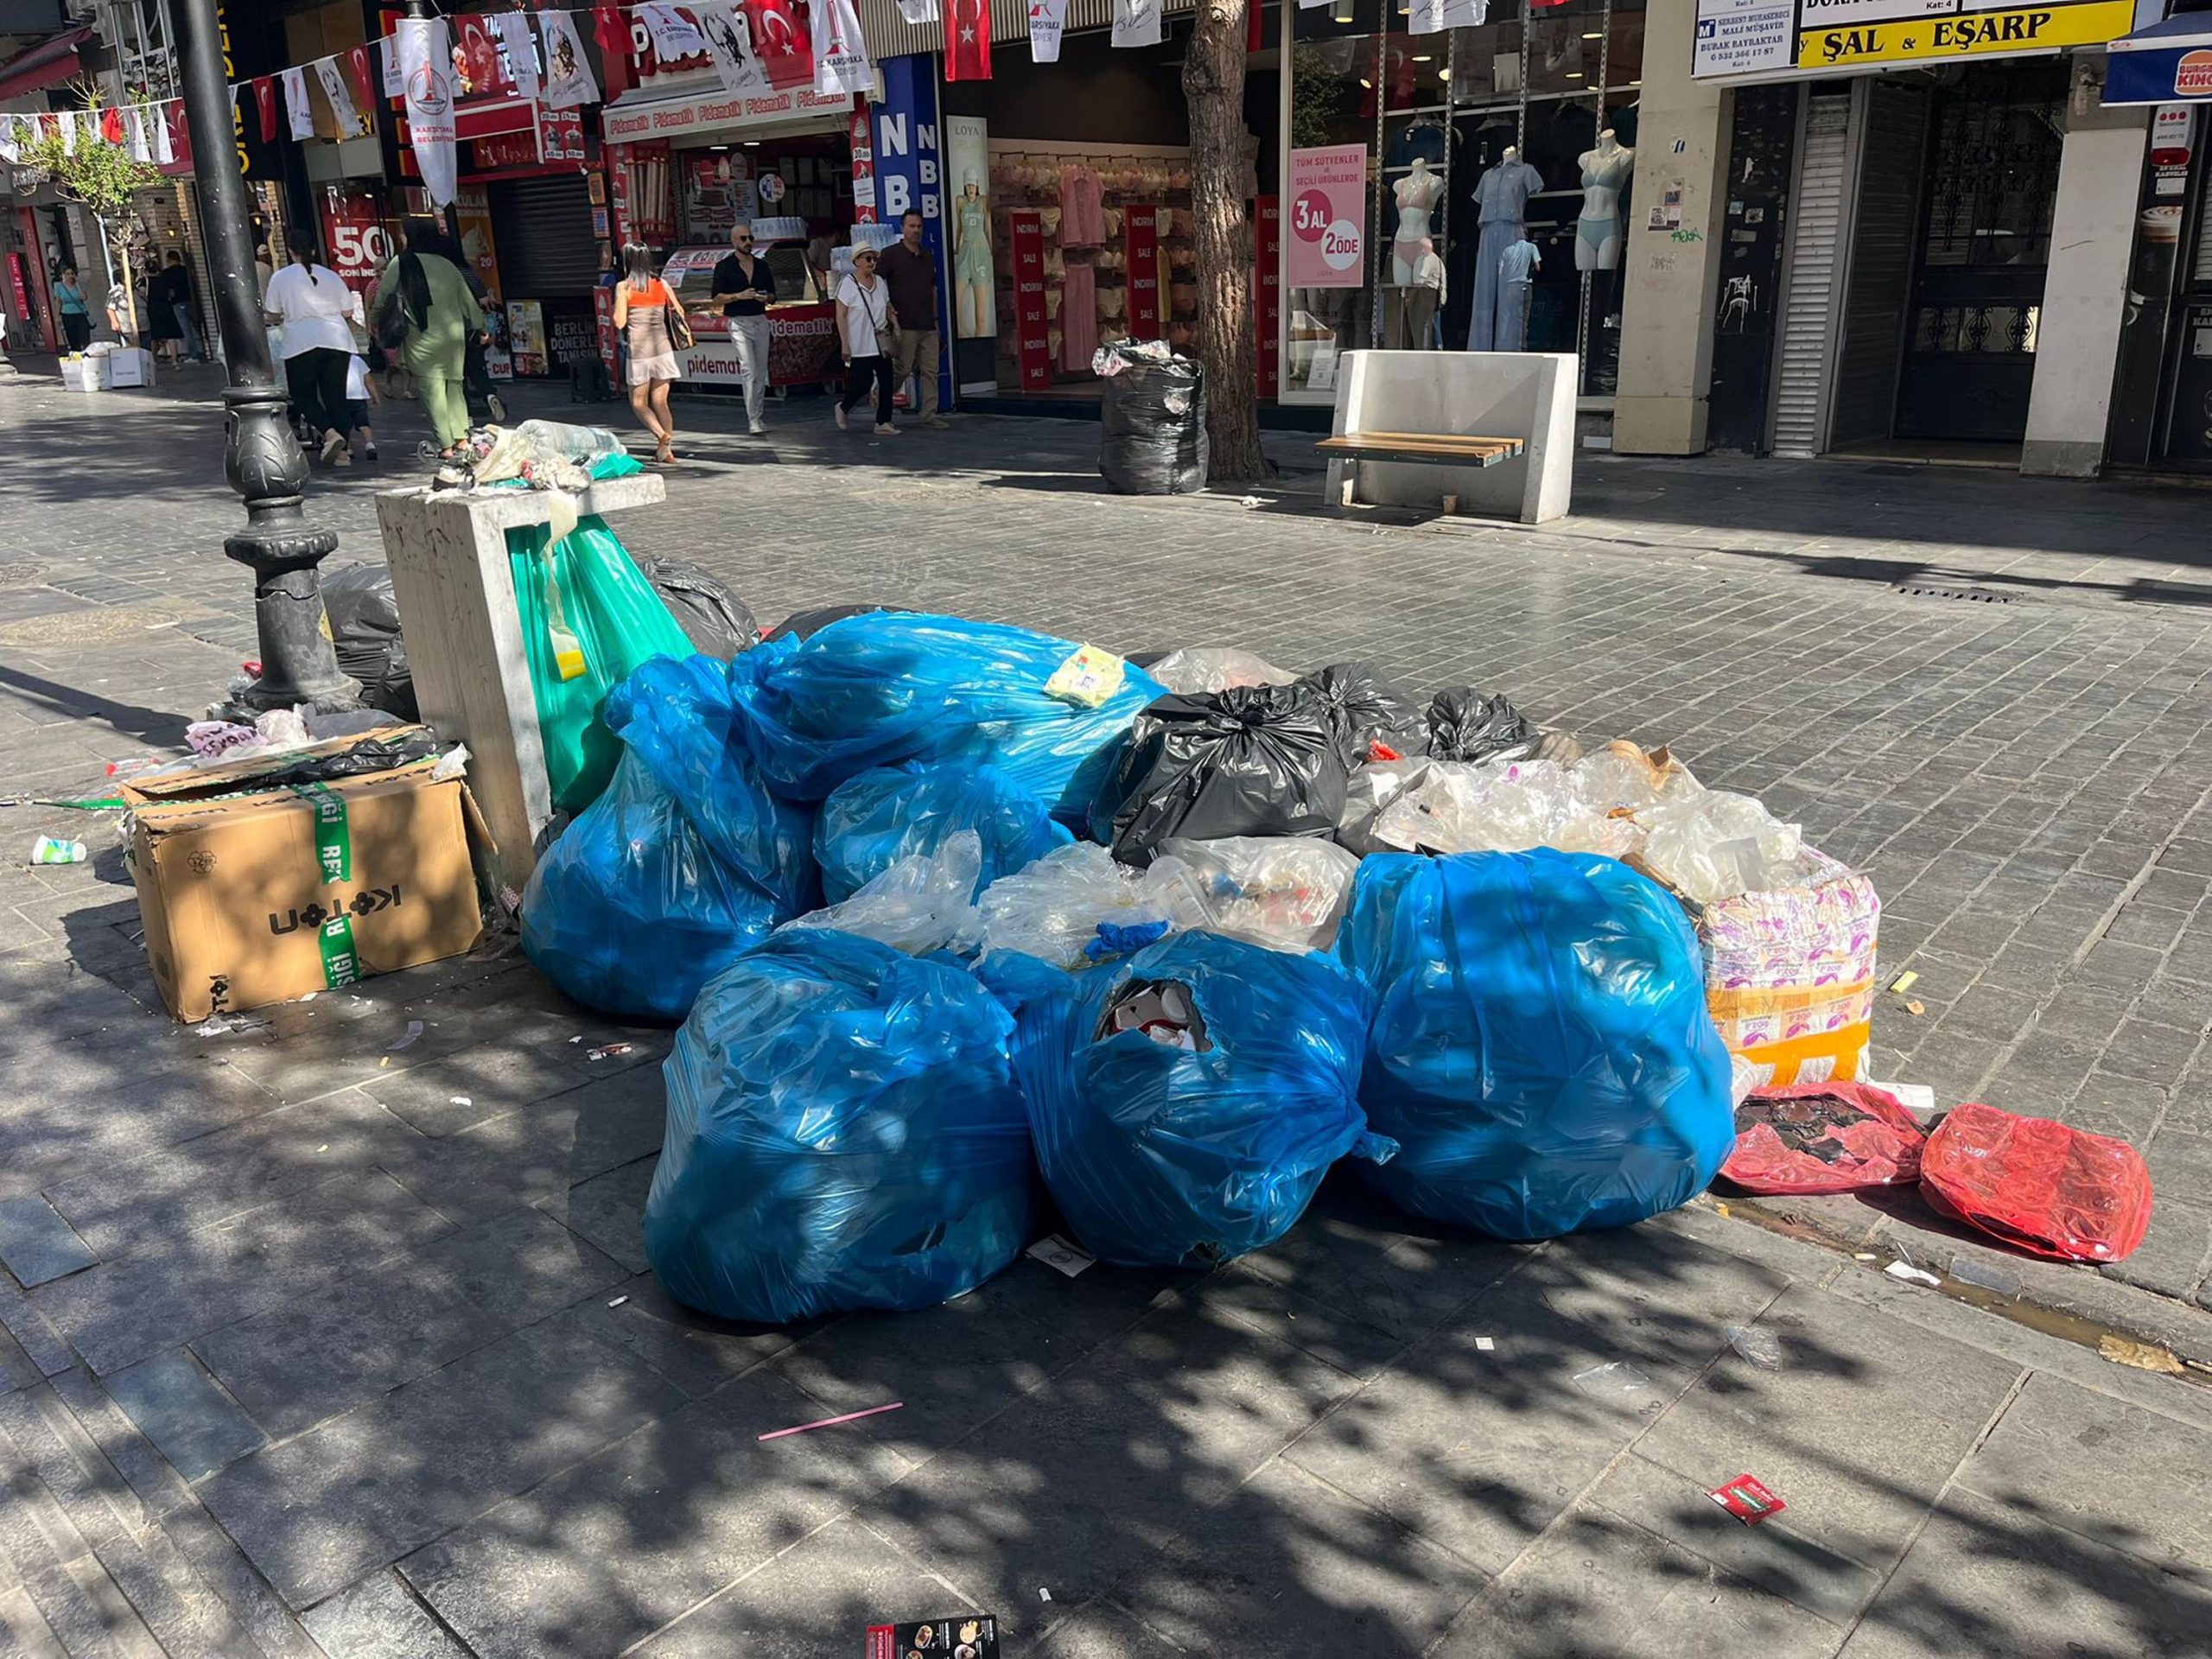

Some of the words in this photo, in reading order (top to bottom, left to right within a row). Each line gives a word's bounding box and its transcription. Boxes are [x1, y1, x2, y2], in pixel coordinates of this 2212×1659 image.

[1031, 20, 1060, 30] ARŞIYAKA
[1721, 25, 1744, 36] MALİ
[1745, 22, 1784, 33] MÜŞAVİR
[1700, 41, 1730, 52] BURAK
[1732, 35, 1783, 48] BAYRAKTAR
[1823, 29, 1885, 62] ŞAL
[1902, 37, 1916, 50] &
[1933, 13, 2051, 49] EŞARP
[698, 100, 741, 122] Pidematik
[746, 92, 791, 115] Pidematik
[954, 125, 980, 137] LOYA
[1296, 159, 1313, 168] TÜM
[1315, 154, 1358, 166] SÜTYENLER
[334, 226, 395, 266] 50
[1137, 248, 1151, 258] SALE
[1140, 309, 1154, 320] SALE
[771, 317, 832, 337] idematik
[688, 354, 741, 378] pidemat
